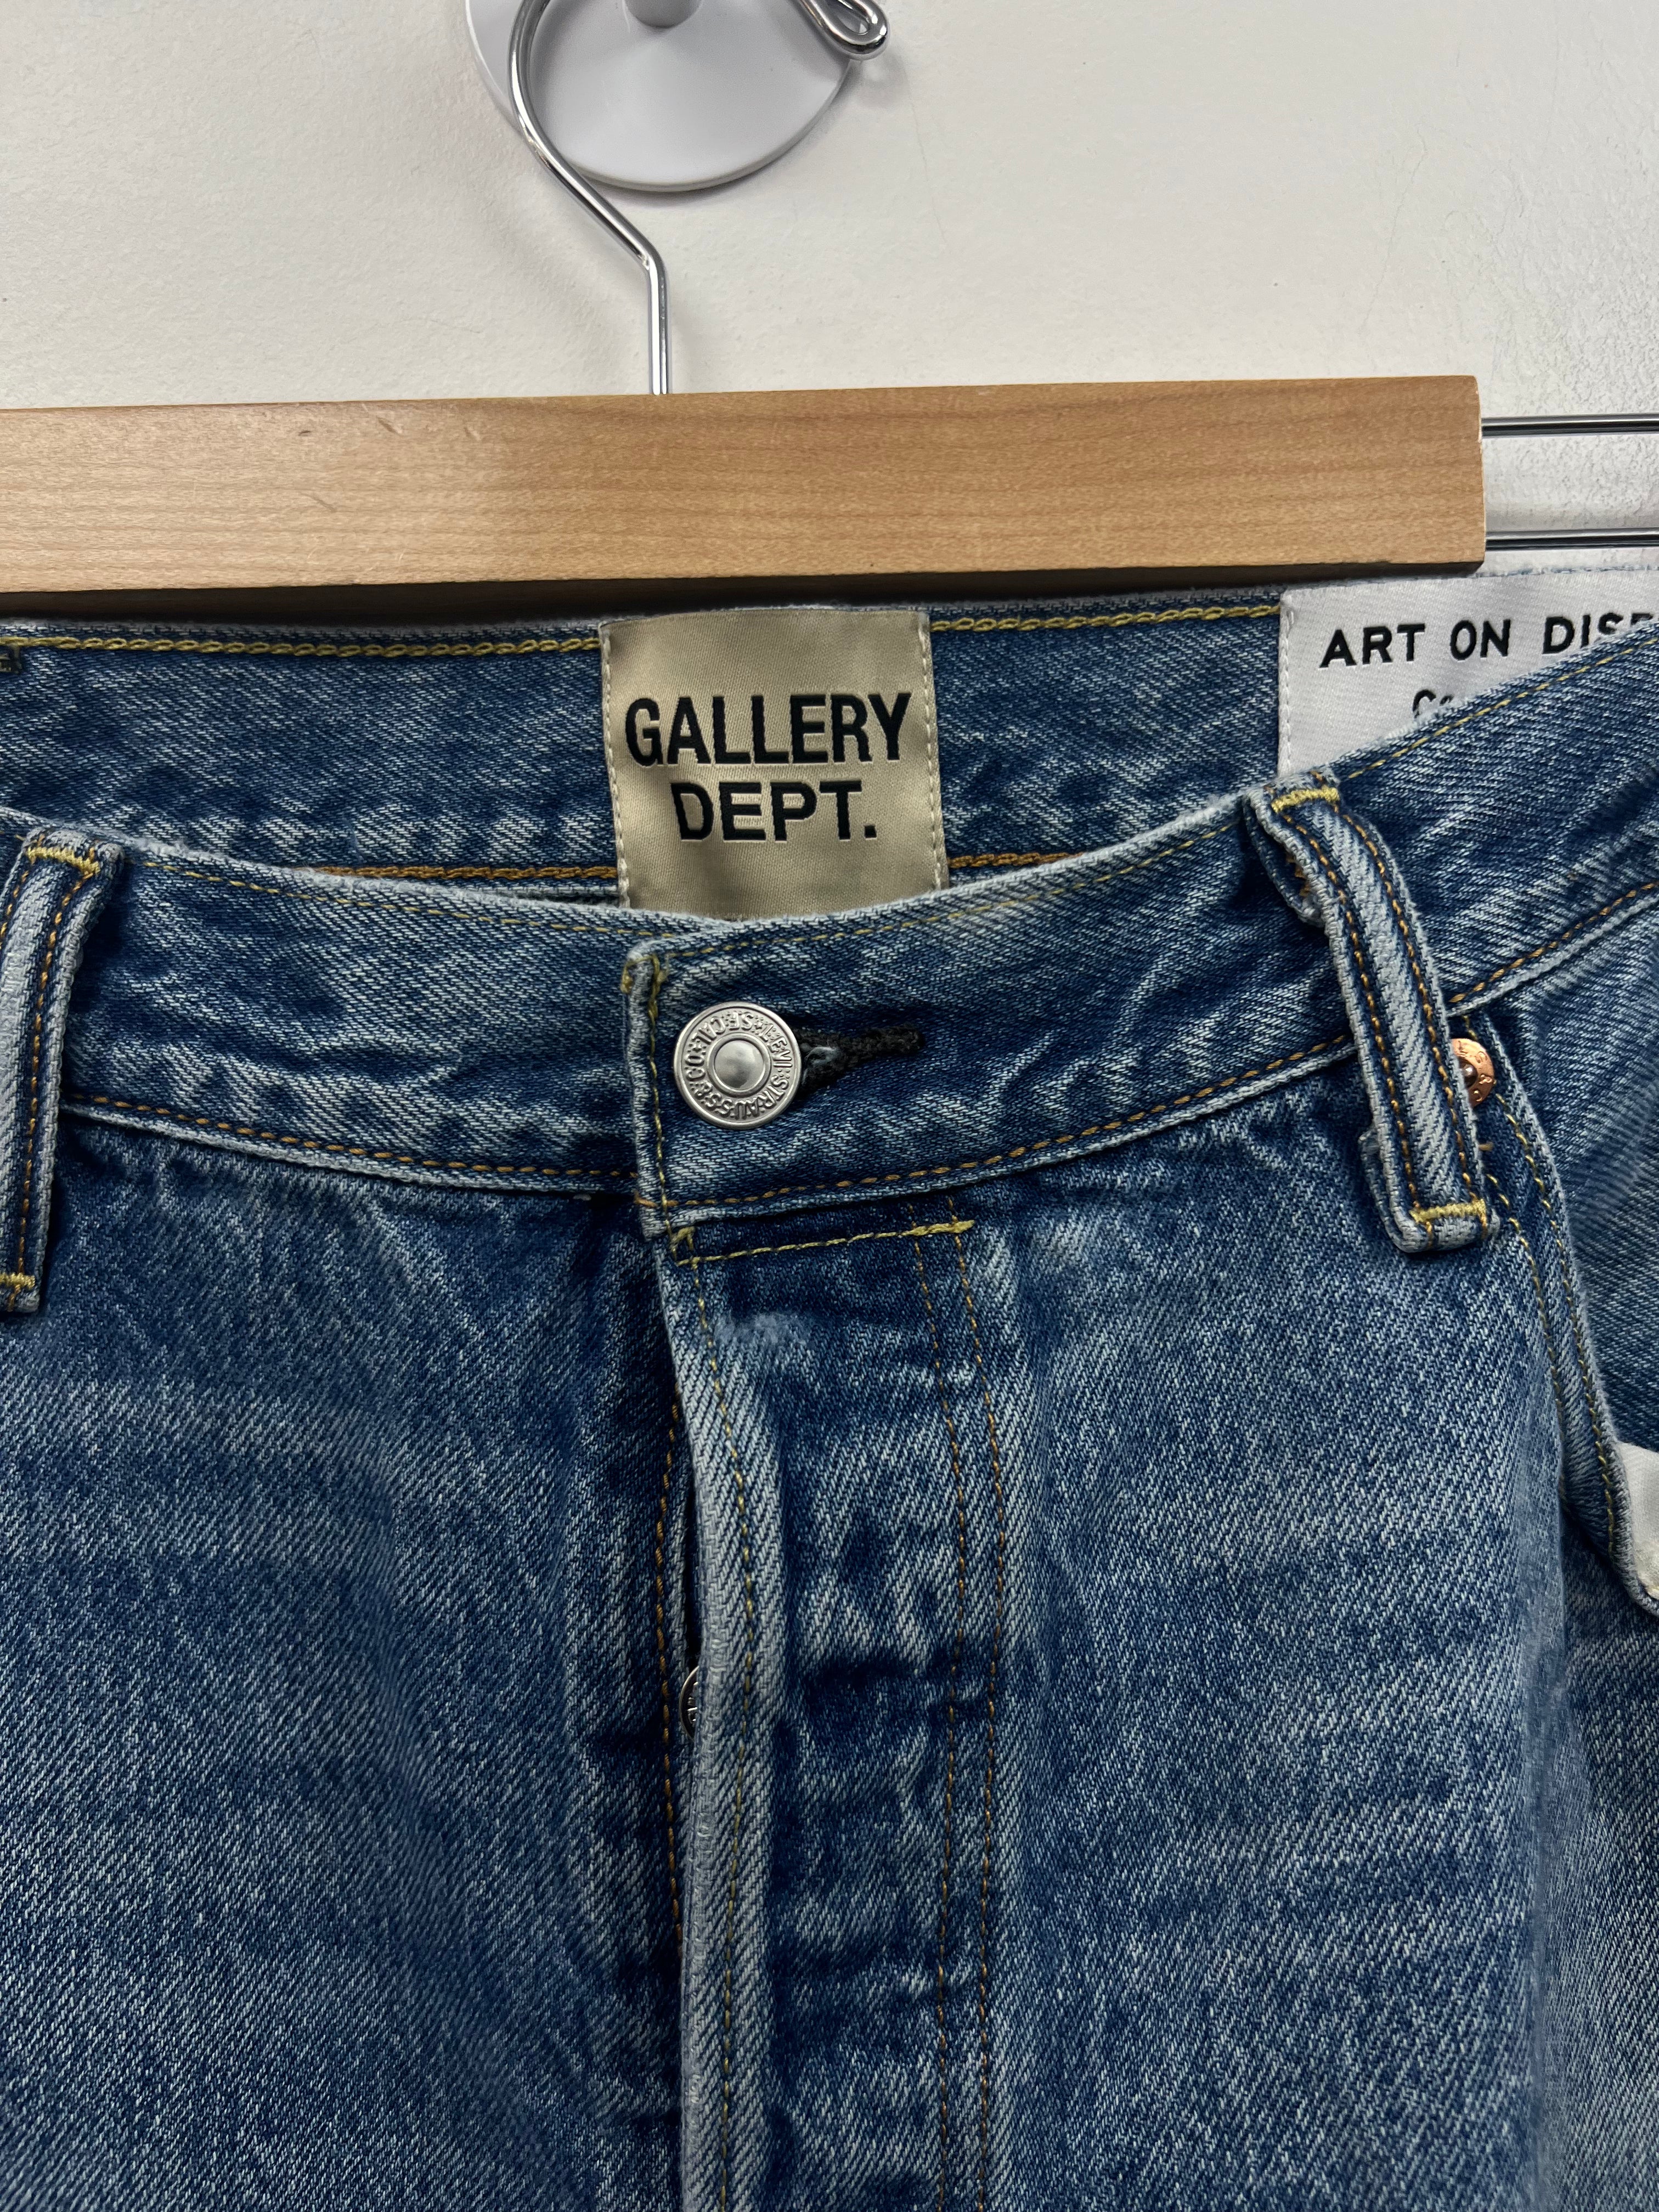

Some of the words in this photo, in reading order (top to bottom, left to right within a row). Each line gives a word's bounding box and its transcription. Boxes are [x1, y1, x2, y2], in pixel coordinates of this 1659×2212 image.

[1319, 623, 1425, 668] ART
[1449, 619, 1512, 660] ON
[625, 692, 912, 766] GALLERY
[671, 780, 877, 841] DEPT.
[758, 1023, 792, 1068] LEVI
[705, 1075, 789, 1120] STRAUSS
